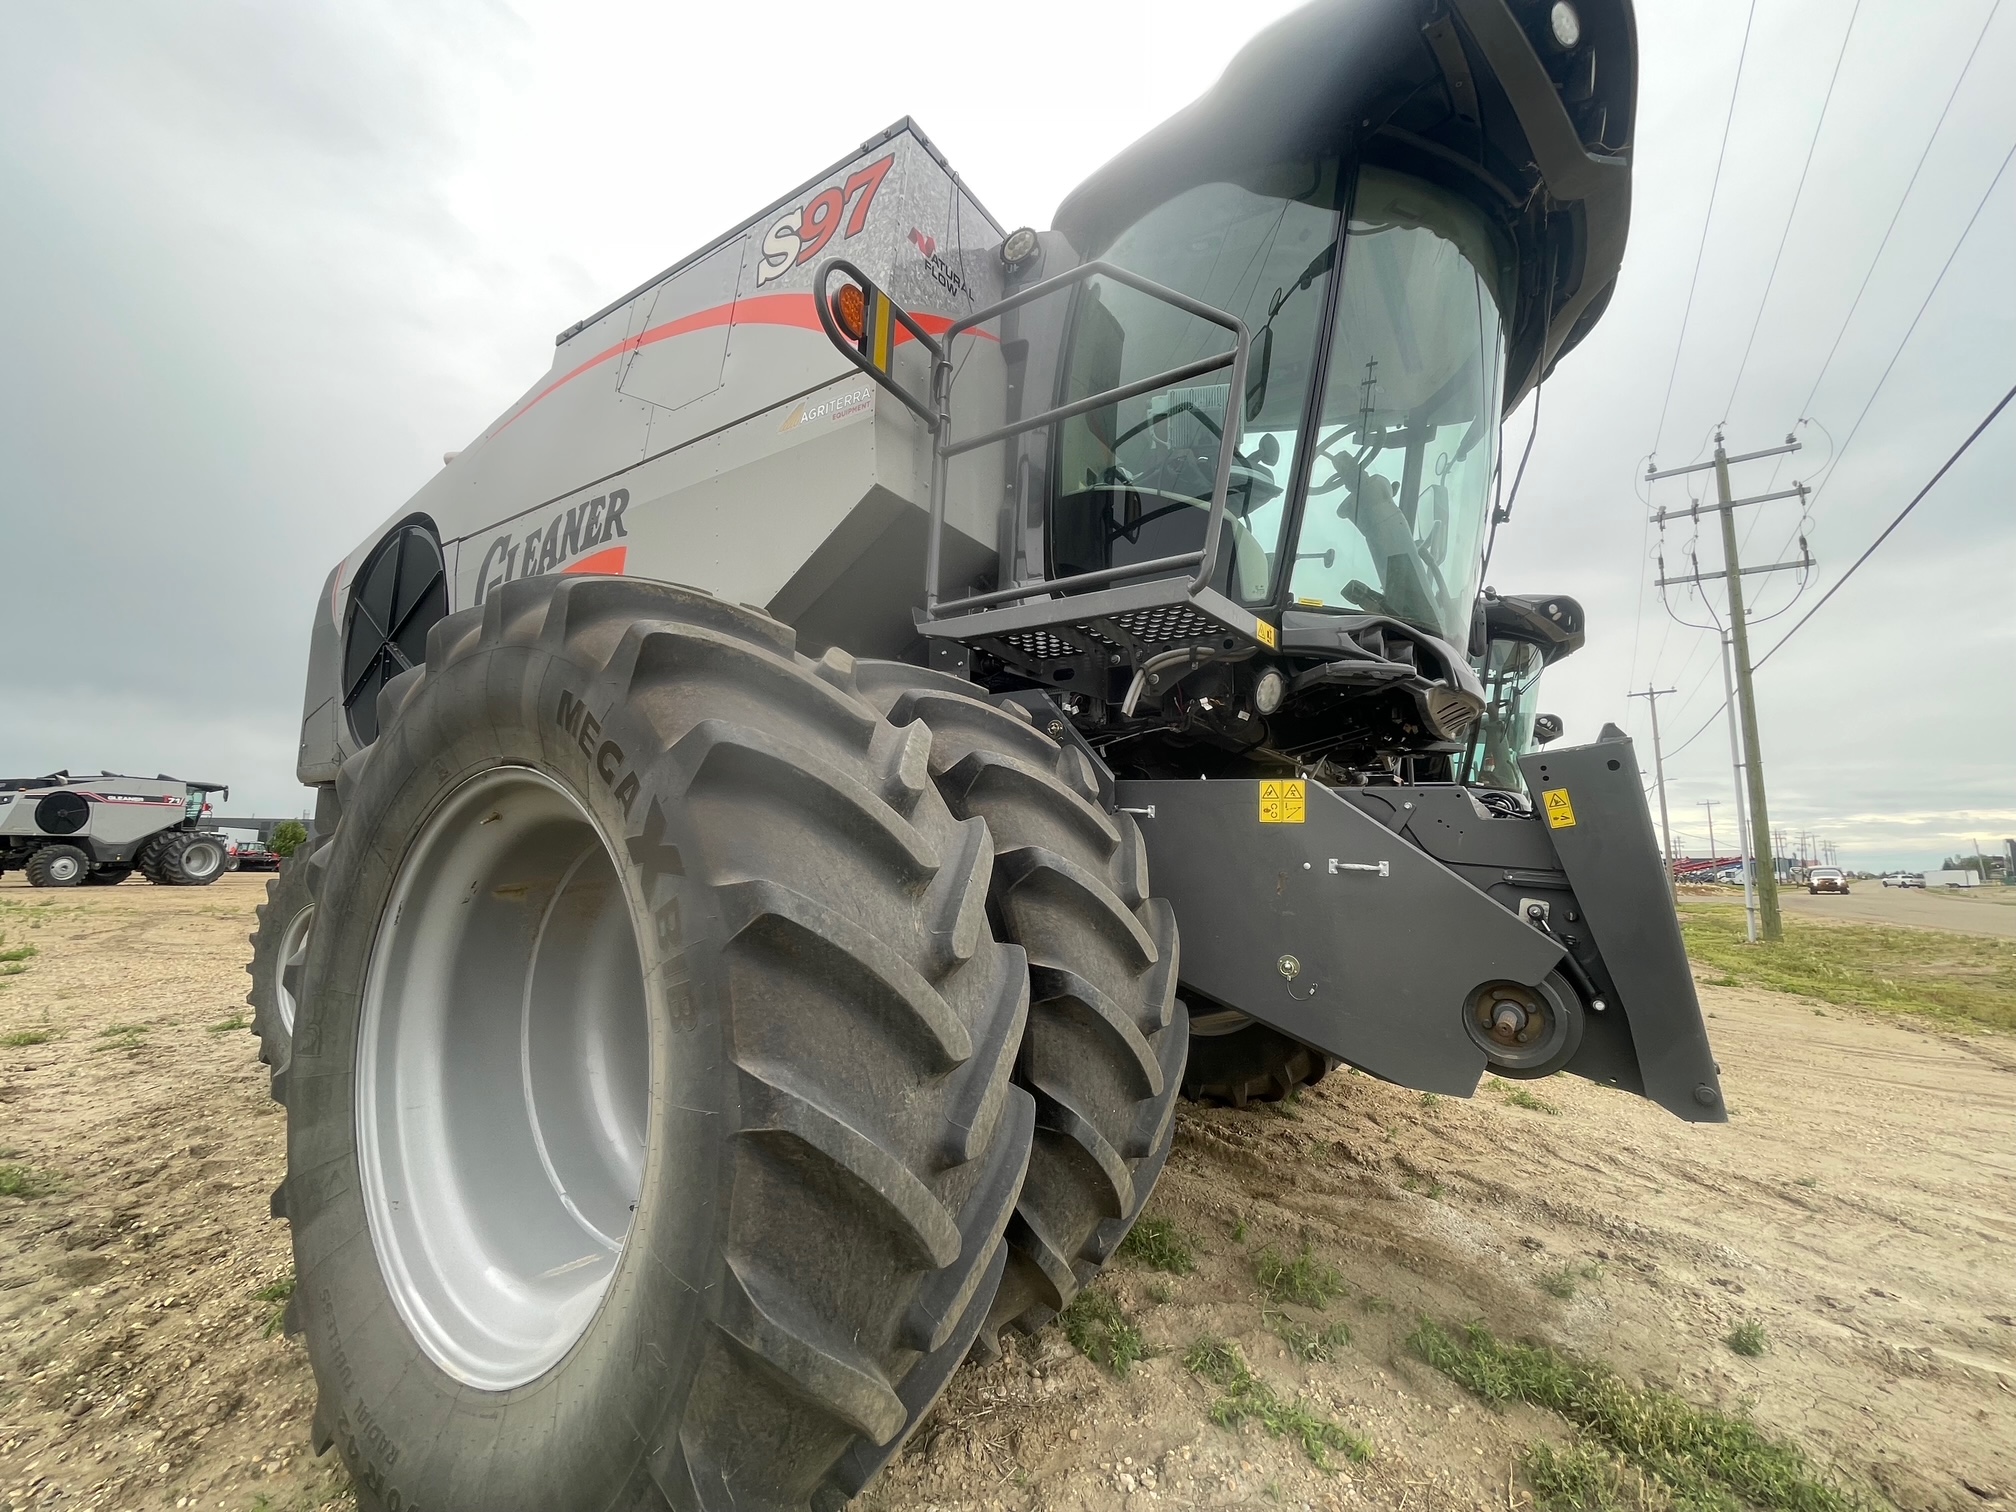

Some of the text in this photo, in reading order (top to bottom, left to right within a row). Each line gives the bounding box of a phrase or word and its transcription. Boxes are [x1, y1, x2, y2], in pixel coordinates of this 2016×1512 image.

[757, 152, 895, 288] S97
[925, 260, 958, 297] FLOW
[800, 388, 871, 423] AGRITERRA
[832, 401, 871, 421] EQUIPMENT
